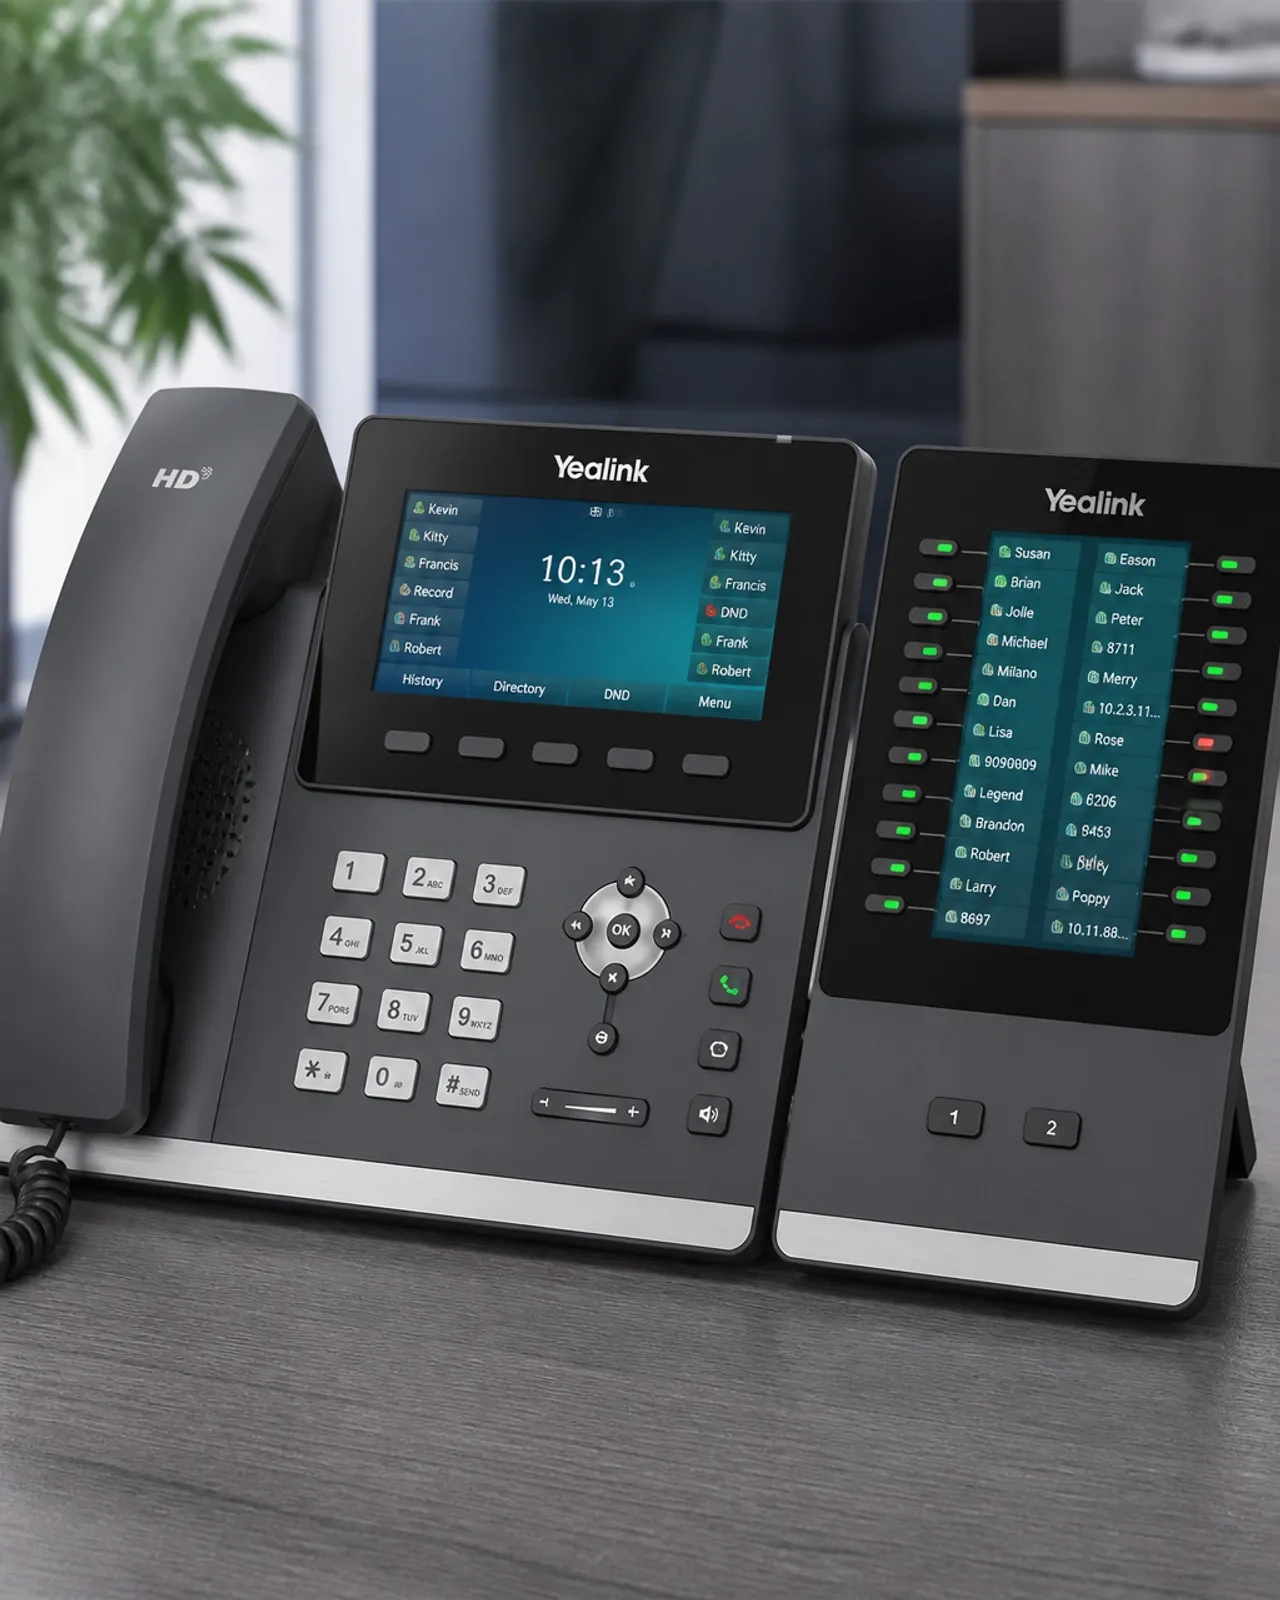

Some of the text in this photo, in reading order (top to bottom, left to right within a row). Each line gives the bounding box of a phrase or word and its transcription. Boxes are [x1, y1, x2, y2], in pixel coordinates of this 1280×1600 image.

[554, 454, 648, 483] Yealink
[152, 468, 200, 490] HD
[428, 503, 458, 516] Kevin
[1045, 488, 1146, 517] Yealink
[734, 522, 766, 535] Kevin
[423, 530, 449, 546] Kitty
[730, 550, 757, 565] Kitty
[1015, 547, 1051, 560] Susan
[1119, 554, 1156, 567] Eason
[418, 558, 459, 571] Francis
[541, 554, 626, 587] 10:13
[725, 579, 766, 592] Francis
[1010, 576, 1041, 590] Brian
[1115, 583, 1144, 596] Jack
[414, 586, 454, 599] Record
[548, 594, 573, 606] Wed,
[602, 596, 614, 608] 13
[721, 607, 748, 619] DND
[1111, 613, 1144, 626] Peter
[409, 614, 441, 627] Frank
[404, 642, 442, 655] Robert
[716, 636, 748, 649] Frank
[1002, 636, 1048, 649] Michael
[1106, 642, 1135, 655] 8711
[711, 664, 752, 678] Robert
[997, 665, 1038, 679] Milano
[402, 674, 443, 689] History
[1102, 672, 1138, 688] Merry
[493, 680, 546, 697] Directory
[604, 689, 630, 701] DND
[698, 696, 732, 709] Menu
[993, 695, 1016, 708] Dan
[988, 726, 1013, 739] Lisa
[1094, 733, 1124, 747] Rose
[1089, 763, 1119, 777] Mike
[979, 788, 1024, 804] Legend
[975, 818, 1025, 833] Brandon
[970, 848, 1011, 863] Robert
[346, 861, 356, 880] 1
[413, 867, 425, 887] 2
[483, 874, 496, 893] 3
[965, 879, 996, 896] Larry
[1072, 890, 1110, 907] Poppy
[960, 912, 991, 926] 8697
[330, 926, 344, 946] 4
[612, 924, 632, 936] OK
[401, 933, 414, 953] 5
[471, 940, 484, 960] 6
[319, 992, 331, 1012] 7
[388, 1000, 401, 1019] 8
[459, 1007, 471, 1026] 9
[377, 1067, 390, 1086] 0
[949, 1109, 958, 1125] 1
[1046, 1120, 1057, 1136] 2
